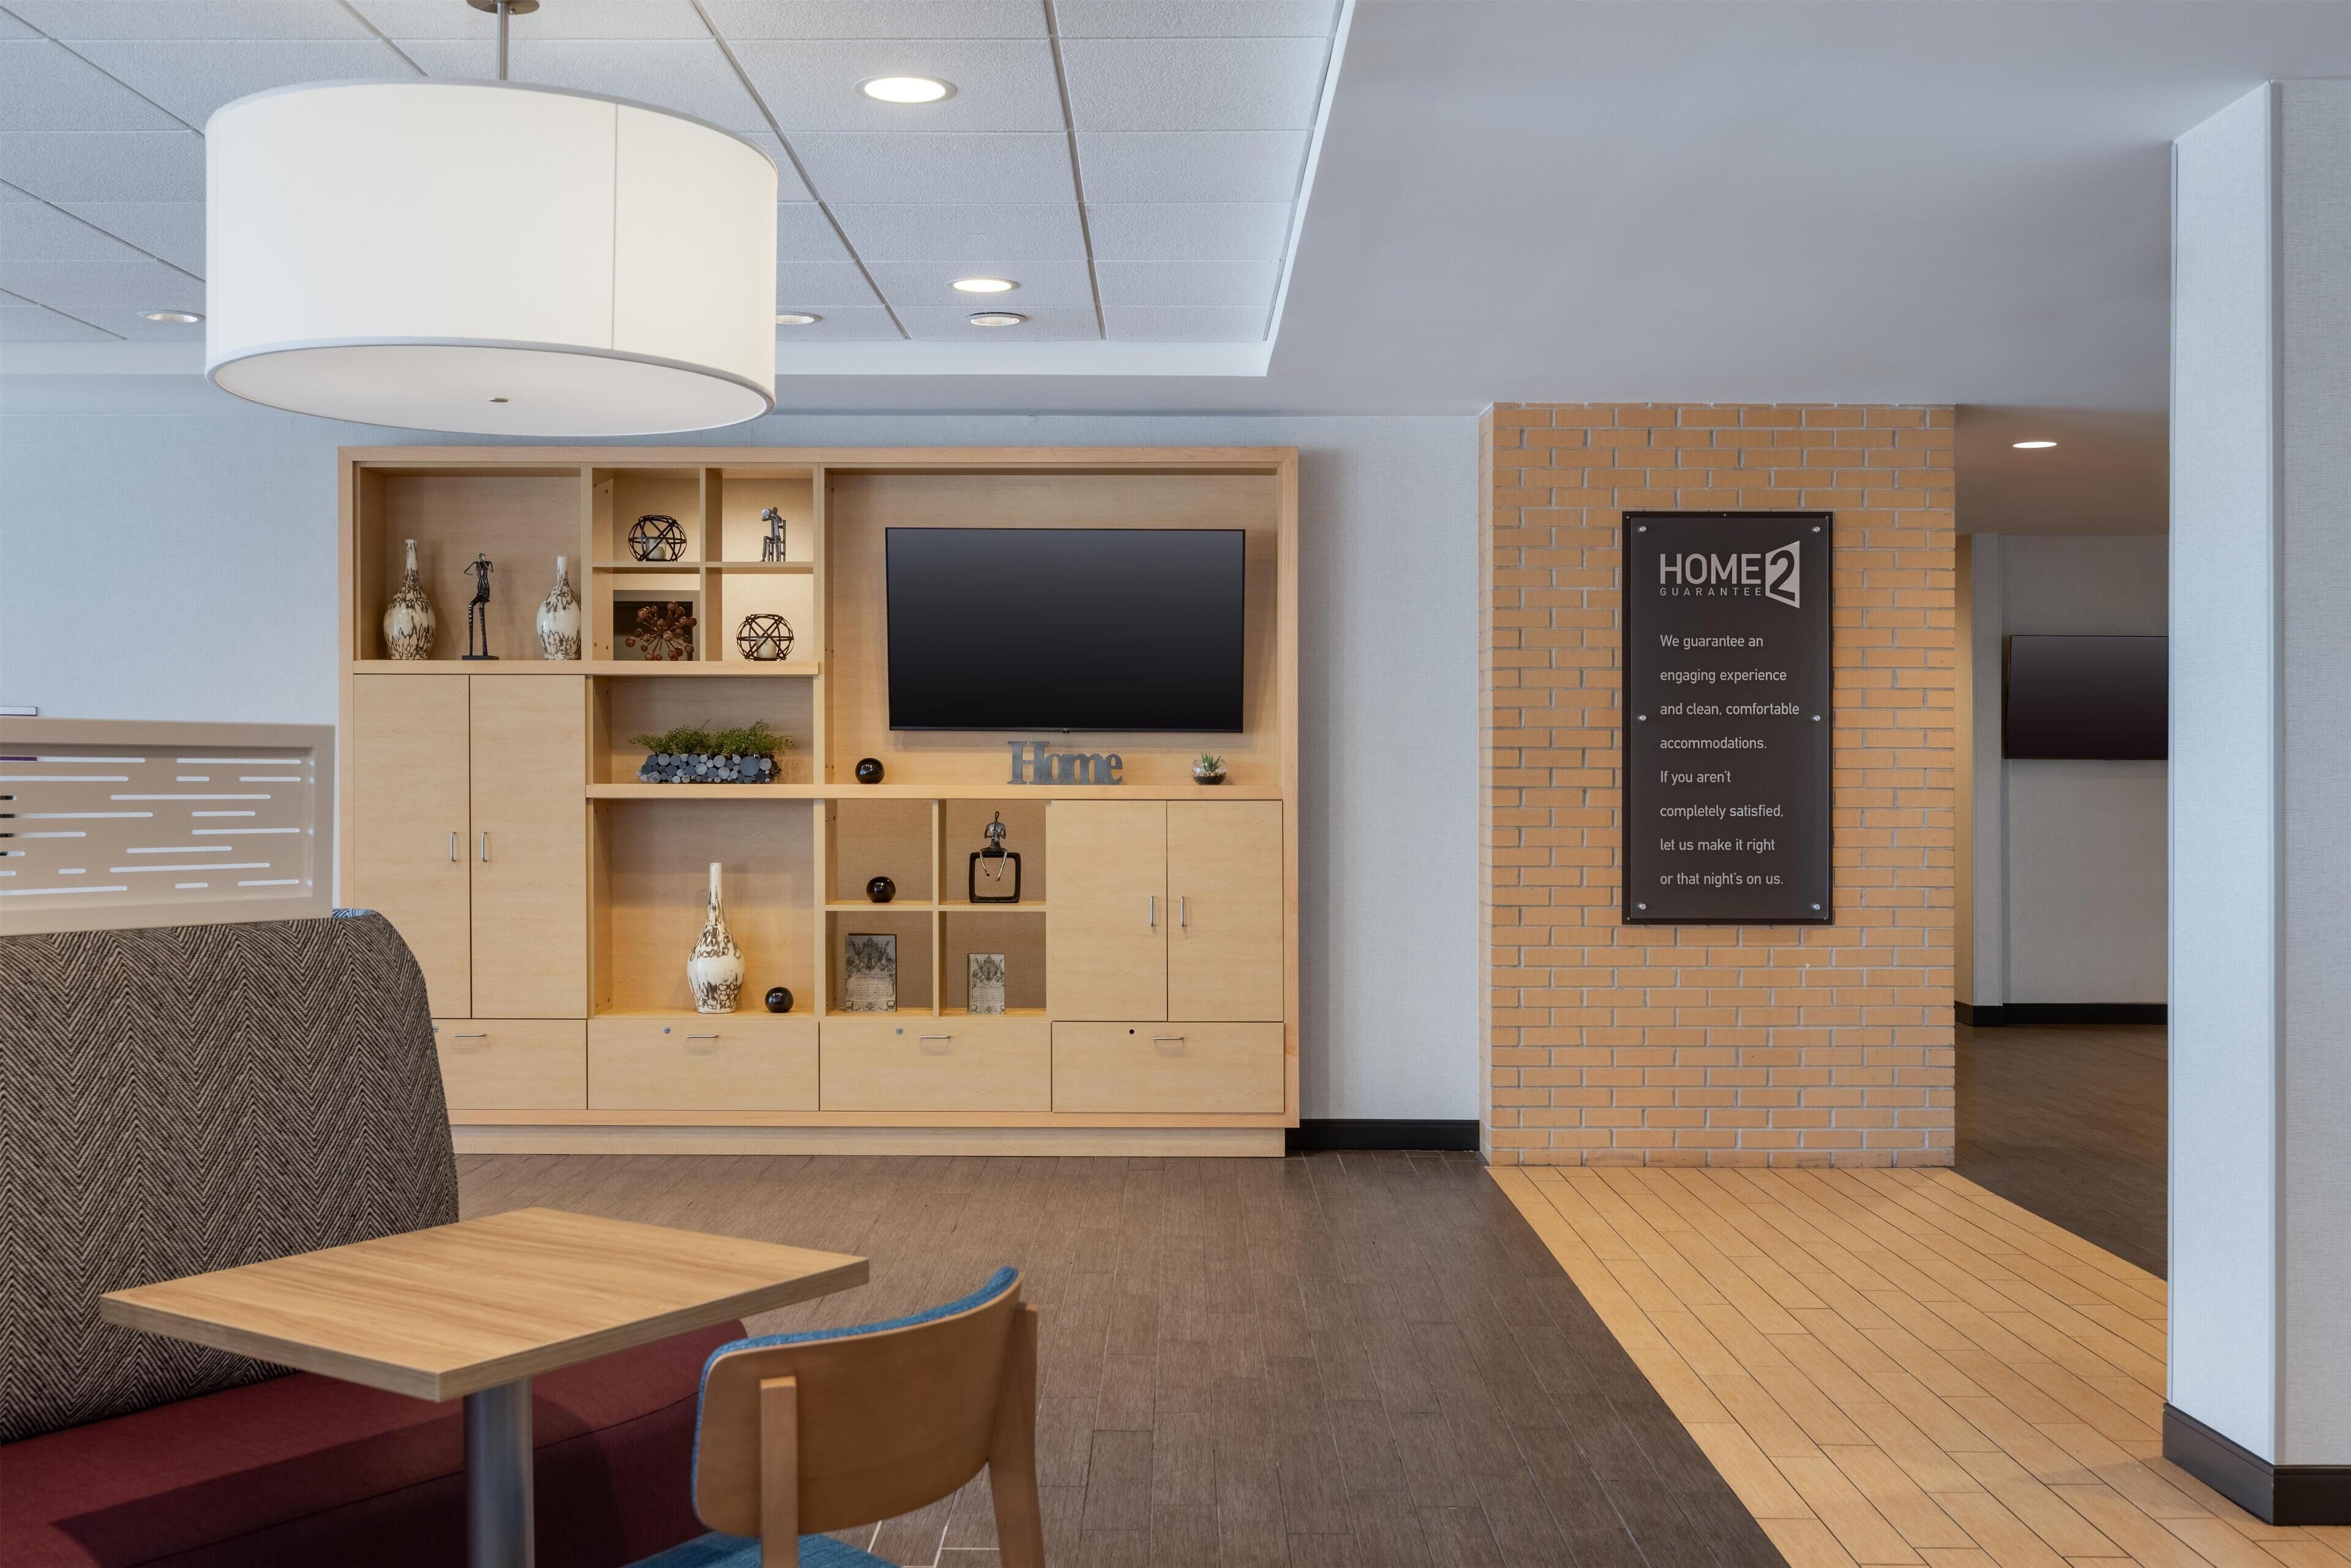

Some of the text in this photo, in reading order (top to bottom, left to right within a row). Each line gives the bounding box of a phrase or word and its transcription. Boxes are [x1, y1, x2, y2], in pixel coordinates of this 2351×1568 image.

[1660, 587, 1761, 596] GUARANTEE
[1660, 634, 1763, 650] We guarantee an
[1660, 668, 1787, 684] engaging experience
[1660, 702, 1799, 716] and clean, comfortable
[1660, 736, 1767, 749] accommodations.
[1007, 740, 1123, 785] Home
[1660, 770, 1731, 786] If you aren't
[1660, 804, 1784, 820] completely satisfied,
[1660, 838, 1775, 854] let us make it right
[1660, 872, 1784, 888] or that night's on us.
